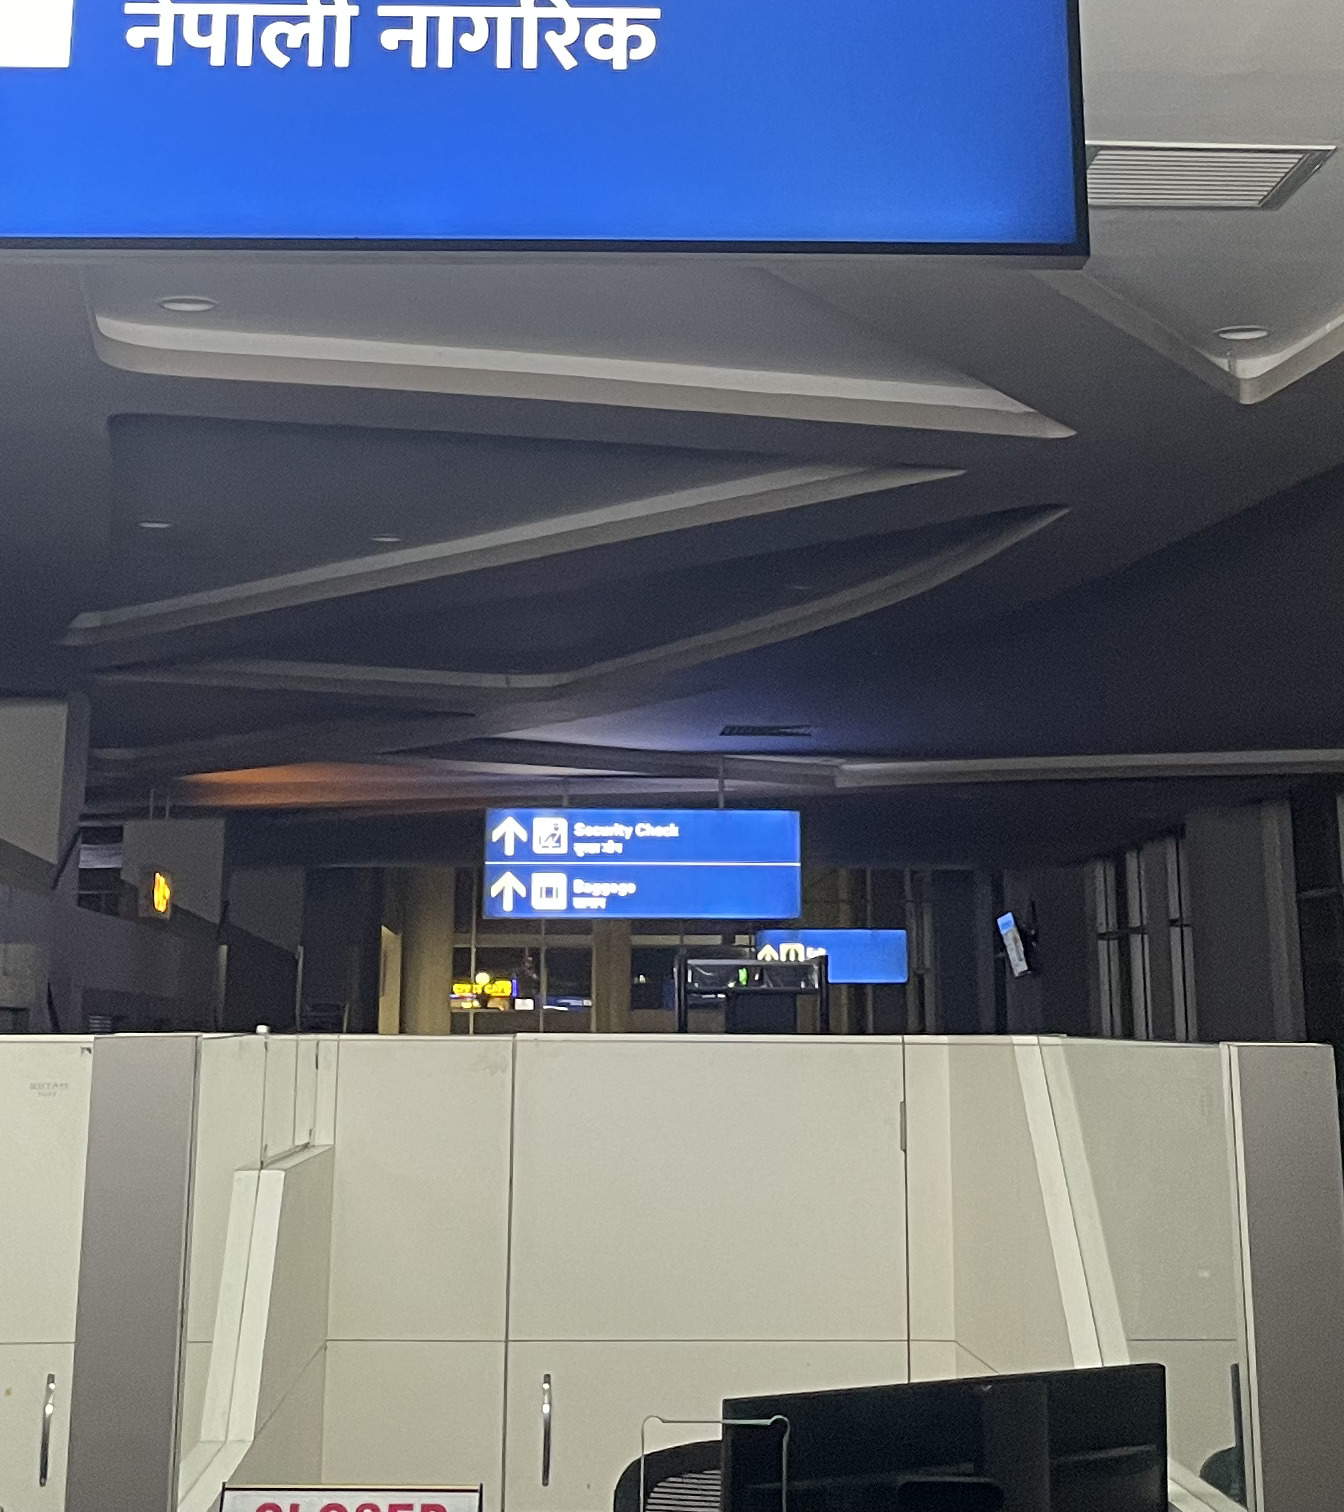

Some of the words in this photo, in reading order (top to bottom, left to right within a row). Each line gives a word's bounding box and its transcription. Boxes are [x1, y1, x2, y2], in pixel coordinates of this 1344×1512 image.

[573, 822, 633, 840] Security
[635, 822, 679, 838] Check
[572, 878, 637, 897] Baggage
